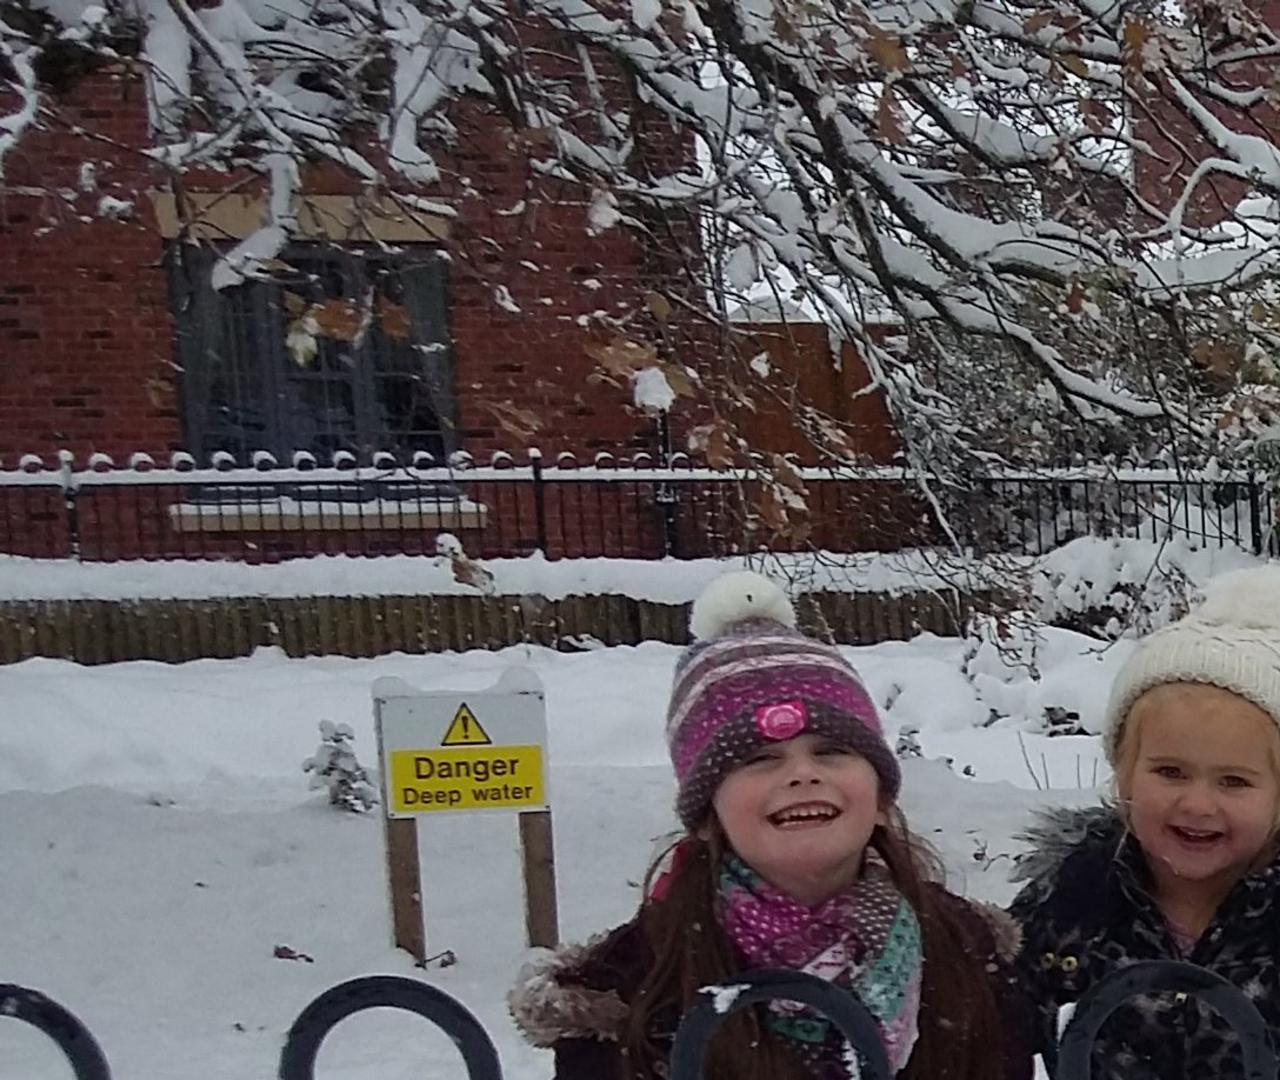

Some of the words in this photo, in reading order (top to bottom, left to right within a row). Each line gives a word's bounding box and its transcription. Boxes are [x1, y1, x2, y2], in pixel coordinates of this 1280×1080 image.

[415, 757, 519, 782] Danger
[402, 787, 462, 806] Deep
[472, 784, 534, 802] water
